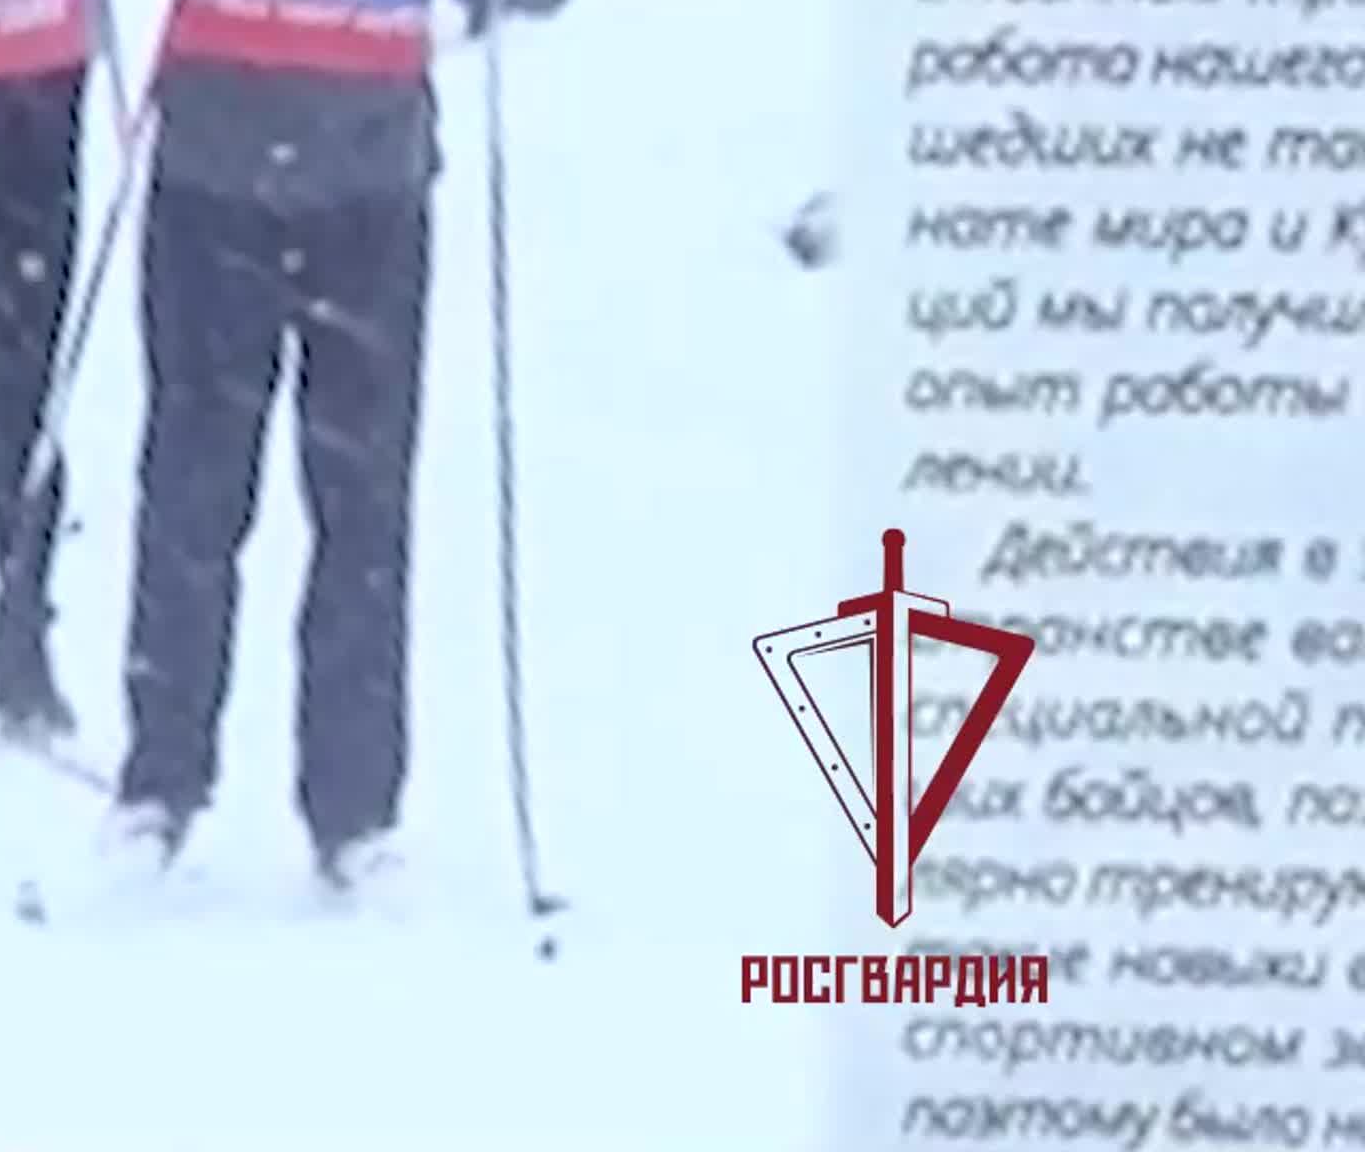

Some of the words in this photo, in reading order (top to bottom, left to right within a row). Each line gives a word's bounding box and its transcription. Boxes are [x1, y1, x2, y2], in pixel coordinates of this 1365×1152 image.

[906, 25, 1137, 96] работа
[909, 108, 1157, 168] шедших
[1174, 126, 1248, 170] не
[907, 207, 1073, 250] нате
[1093, 205, 1249, 264] мира
[1271, 207, 1307, 250] и
[907, 278, 1019, 343] ций
[1035, 285, 1129, 330] мы
[904, 369, 1079, 416] опыт
[1098, 359, 1349, 430] работы
[977, 520, 1284, 584] Действия
[1303, 535, 1337, 582] в
[902, 1016, 1305, 1077] спортивном
[901, 1096, 1159, 1152] поэтому
[1171, 1086, 1309, 1148] было
